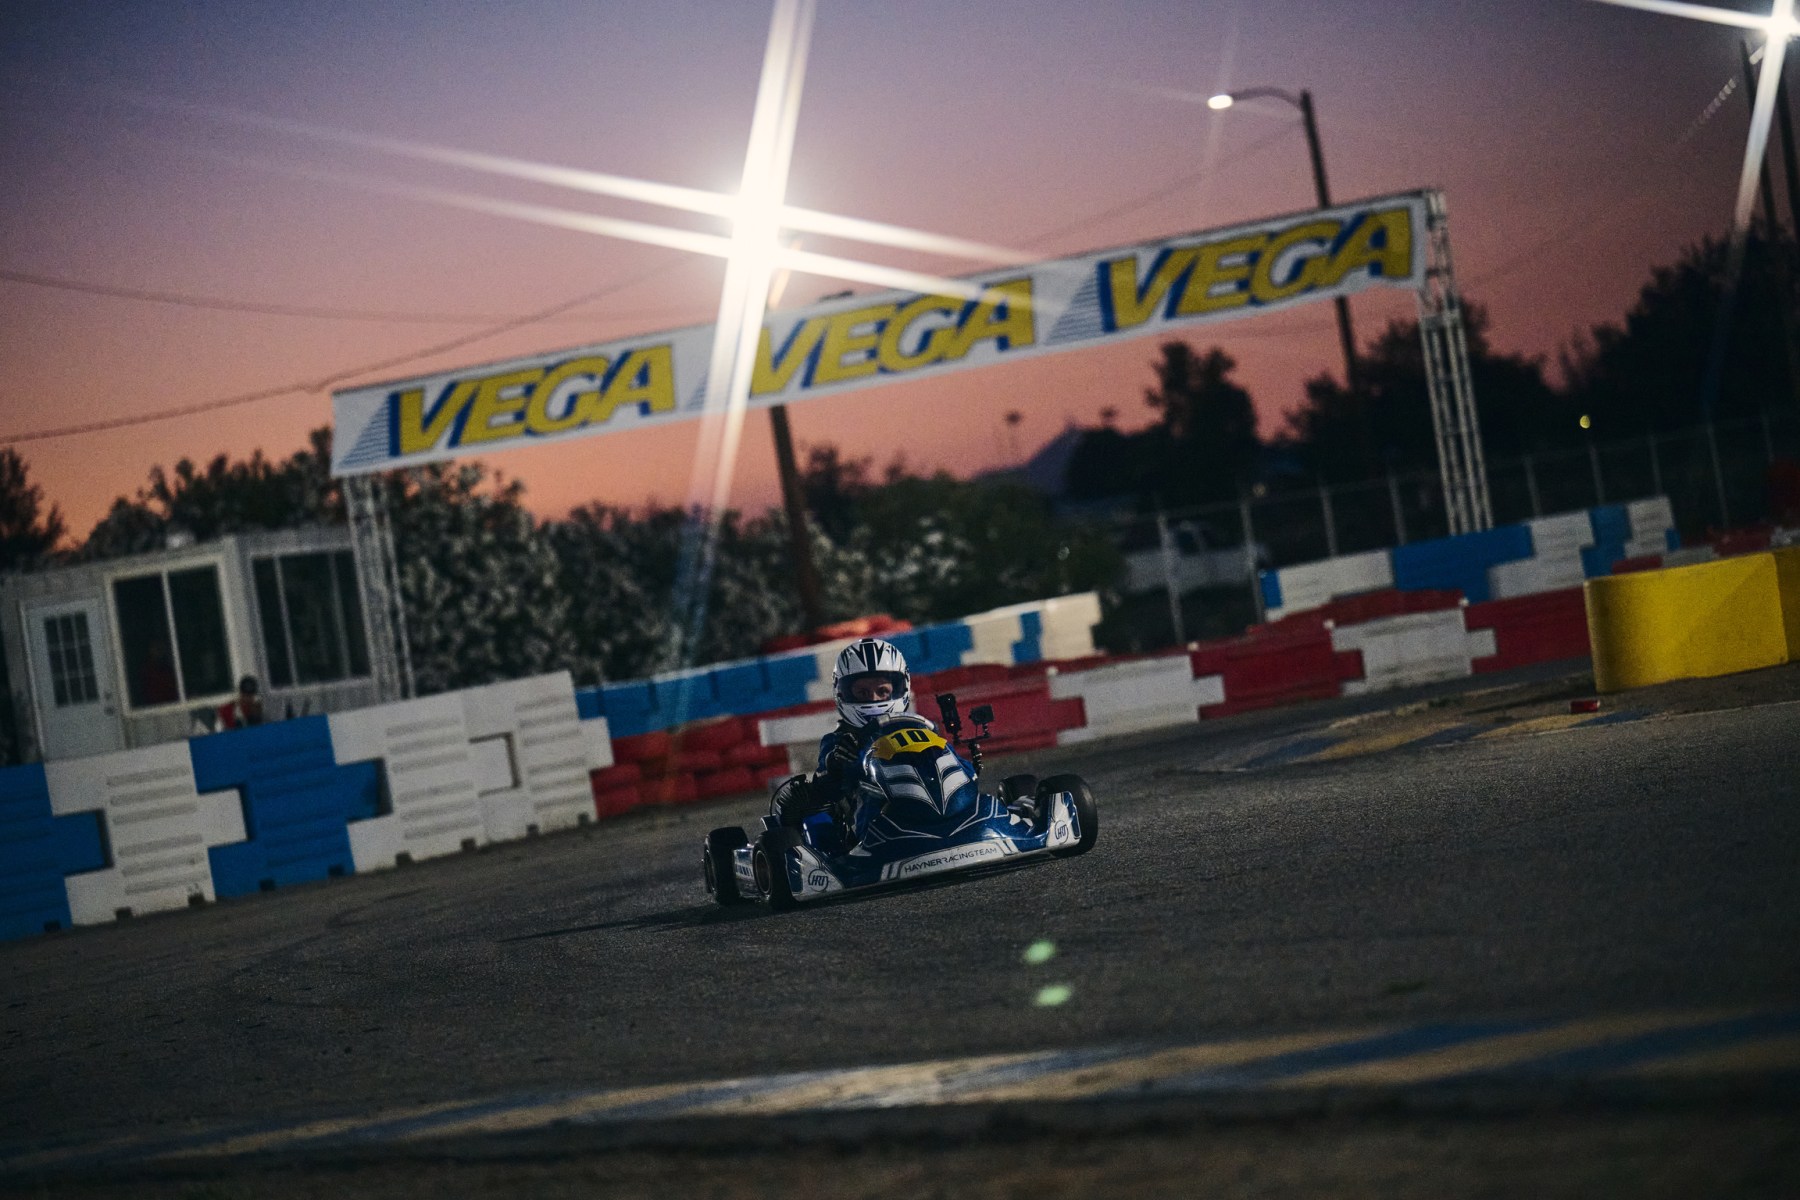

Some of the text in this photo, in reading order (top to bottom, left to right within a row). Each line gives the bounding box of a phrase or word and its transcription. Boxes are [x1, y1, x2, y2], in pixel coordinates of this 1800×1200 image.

[388, 207, 1412, 458] VEGA VEGA VEGA
[890, 729, 931, 747] 10
